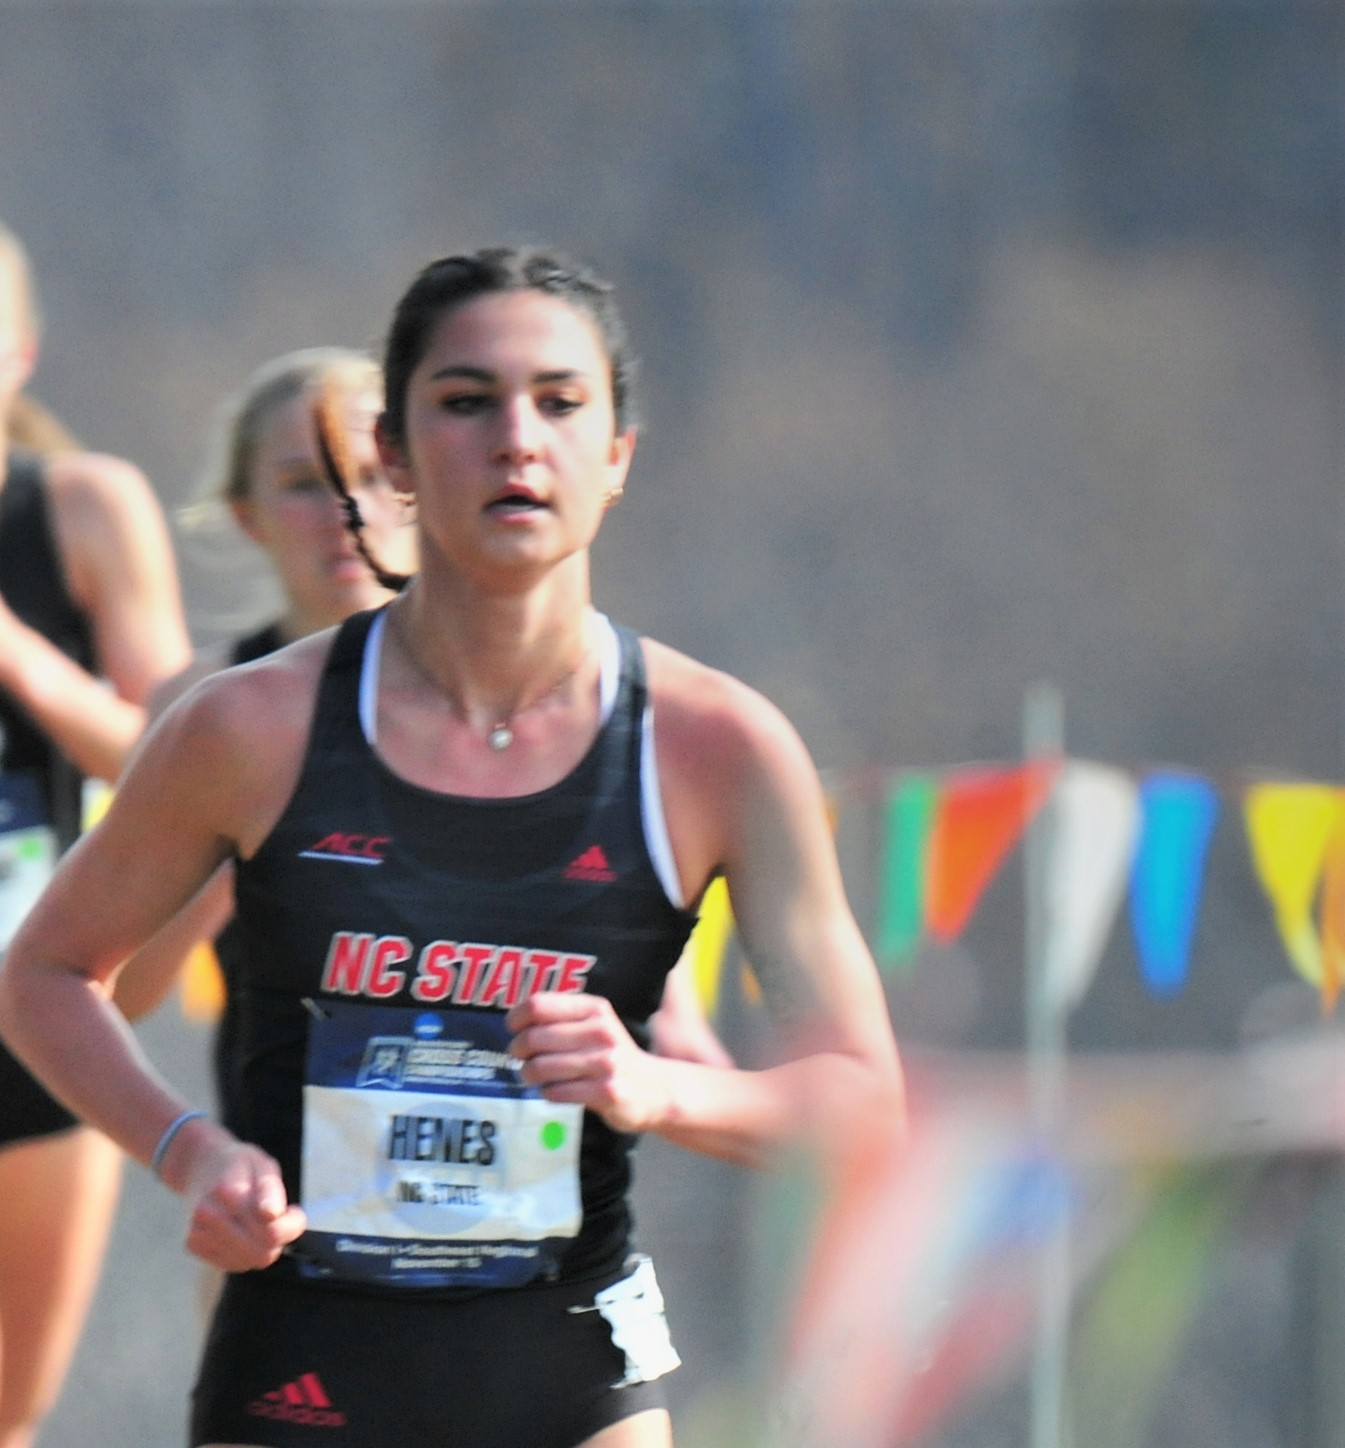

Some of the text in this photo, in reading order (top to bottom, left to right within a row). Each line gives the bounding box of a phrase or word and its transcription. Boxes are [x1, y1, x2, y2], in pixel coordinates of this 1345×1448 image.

[308, 832, 392, 858] ACC
[320, 931, 597, 1009] NC STATE
[388, 1115, 495, 1165] HENES
